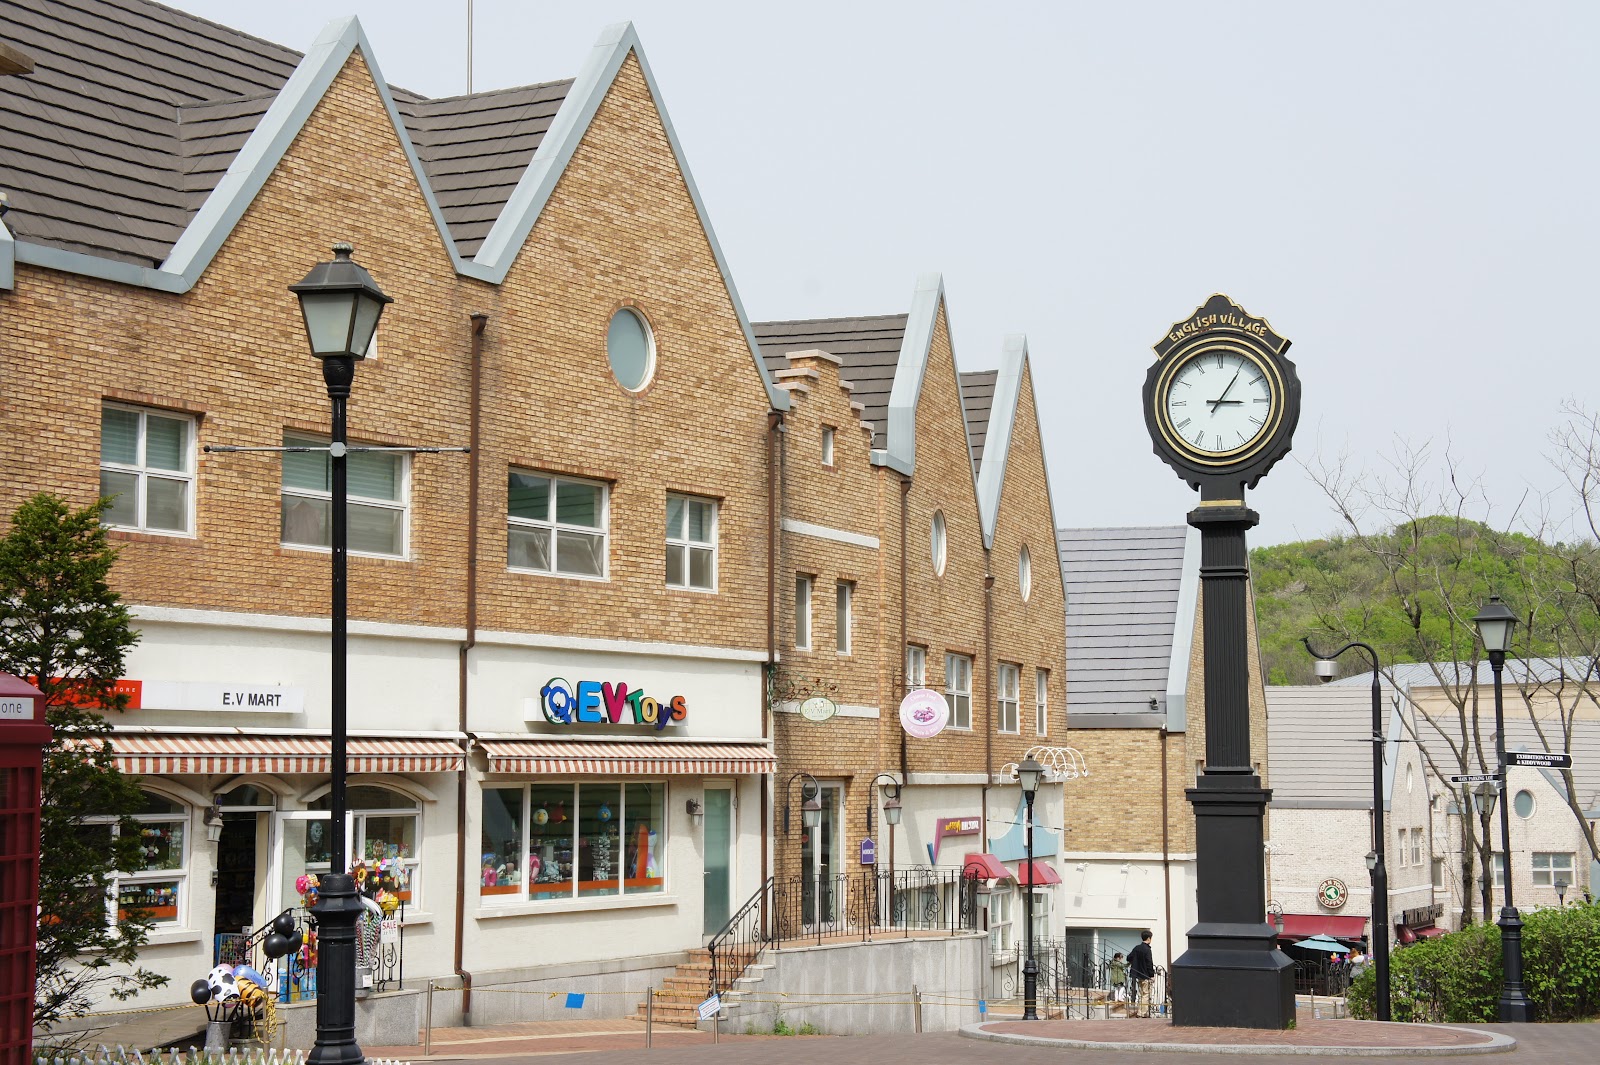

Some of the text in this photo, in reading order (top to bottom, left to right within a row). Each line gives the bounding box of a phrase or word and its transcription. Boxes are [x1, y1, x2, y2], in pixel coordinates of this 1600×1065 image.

[1169, 312, 1268, 342] ENGLISH VILLAGE
[222, 692, 282, 706] E.V MART
[1319, 881, 1328, 893] TOM
[1333, 880, 1345, 894] TOMS
[1320, 896, 1344, 906] COFFEE
[382, 921, 397, 931] SALE
